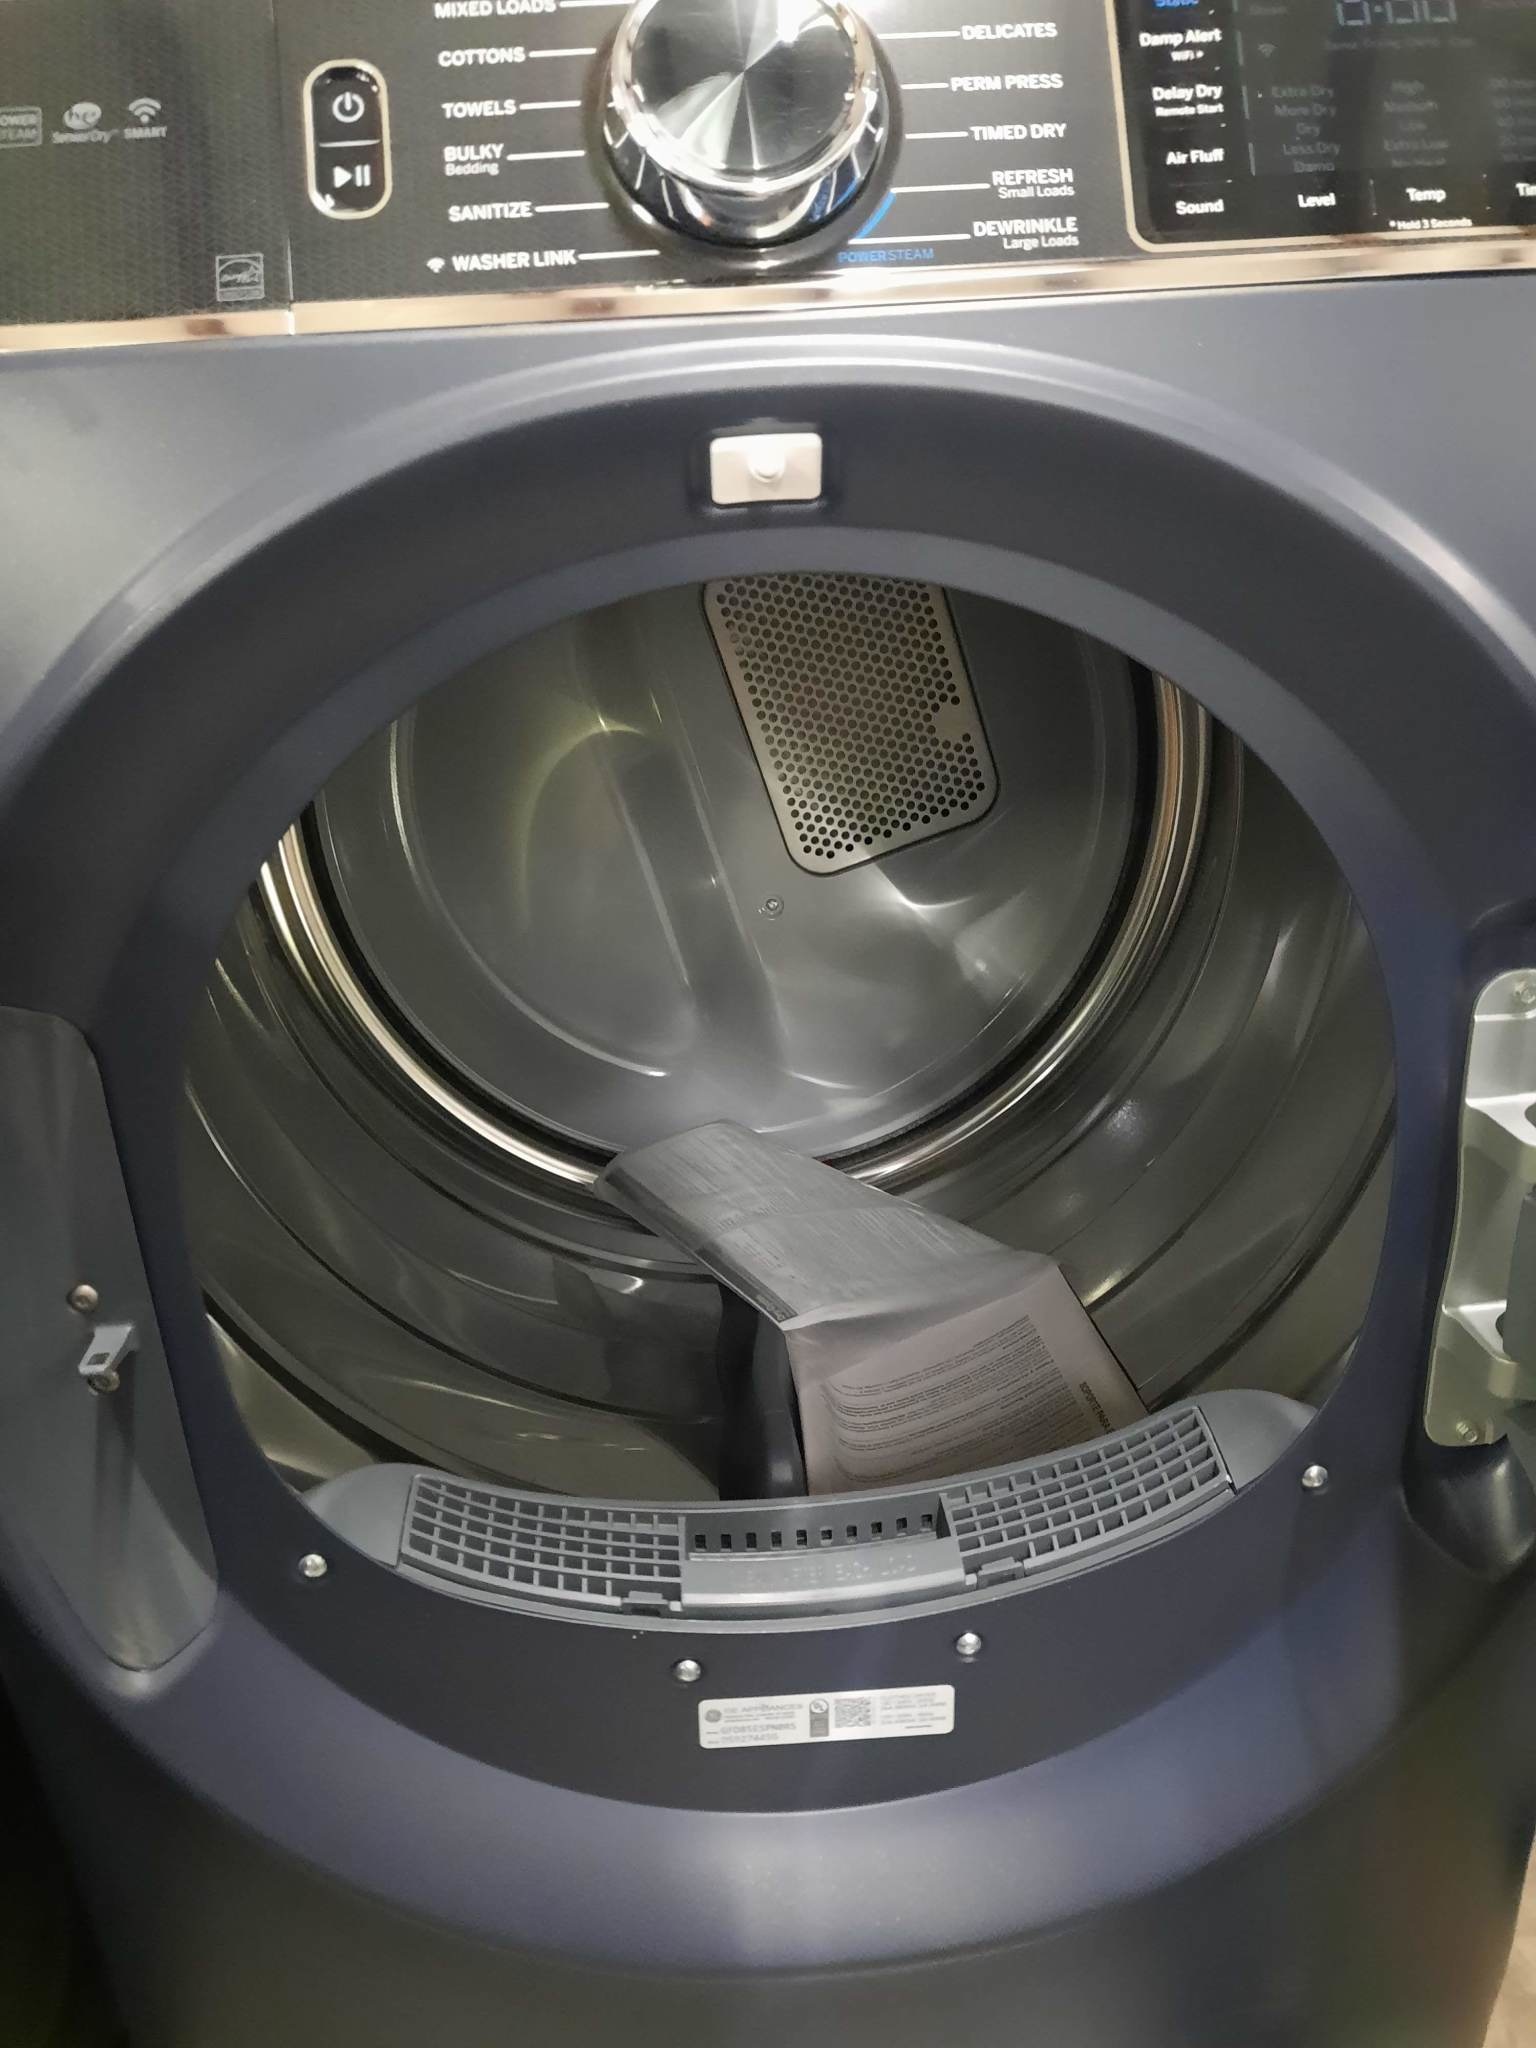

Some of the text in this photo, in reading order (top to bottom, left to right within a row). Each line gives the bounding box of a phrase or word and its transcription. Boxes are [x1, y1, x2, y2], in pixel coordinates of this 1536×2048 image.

[433, 0, 557, 19] MIXED LOADS
[960, 22, 1058, 41] DELICATES
[1138, 28, 1222, 48] Damp Alert
[437, 46, 527, 68] COTTONS
[950, 73, 1064, 92] PERM PRESS
[1151, 83, 1223, 102] Delay Dry
[441, 98, 517, 119] TOWELS
[1155, 103, 1225, 117] Remote Start
[969, 122, 1067, 141] TIMED DRY
[443, 143, 505, 162] BULKY
[1166, 147, 1225, 165] Air Fluff
[444, 162, 500, 177] Bedding
[991, 167, 1074, 184] REFRESH
[997, 184, 1075, 199] Small Loads
[1297, 192, 1336, 208] Level
[1405, 187, 1447, 203] Temp
[448, 200, 534, 223] SANITIZE
[1175, 198, 1225, 215] Sound
[972, 216, 1079, 237] DEWRINKLE
[1396, 216, 1474, 231] Hold 3 Seconds
[1002, 234, 1080, 251] Large Loads
[451, 249, 578, 272] WASHER LINK
